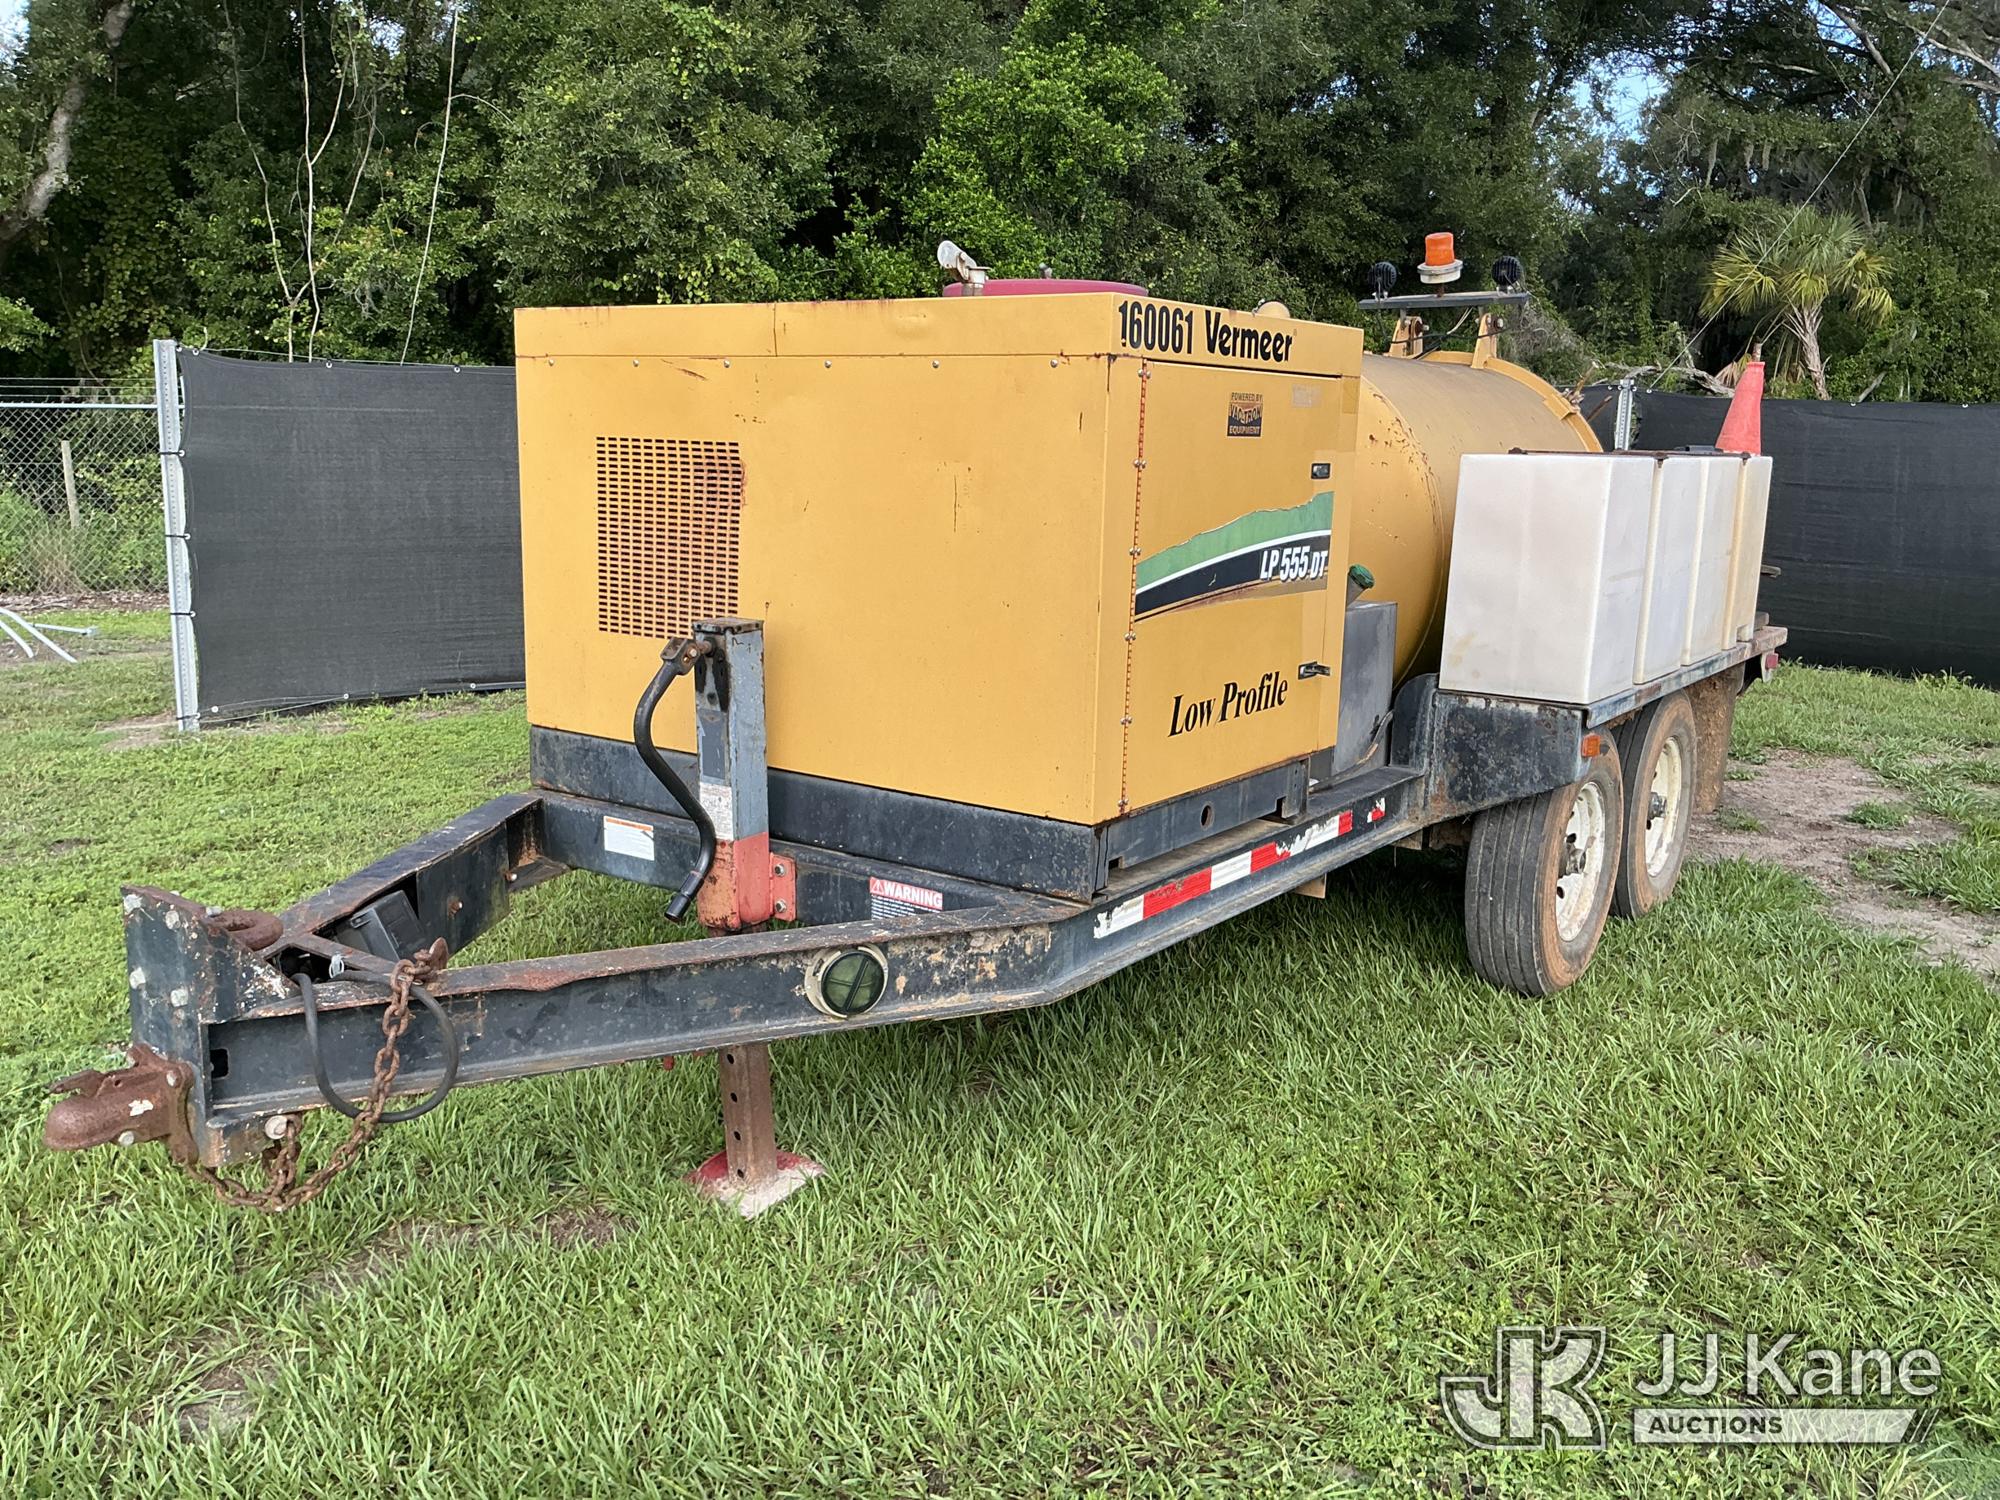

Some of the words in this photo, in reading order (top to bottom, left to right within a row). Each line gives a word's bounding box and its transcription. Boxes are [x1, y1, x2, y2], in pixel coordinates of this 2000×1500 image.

[1119, 300, 1193, 354] 160061
[1205, 309, 1292, 362] Vermeer
[1229, 425, 1261, 435] EQUIPMENT
[1260, 549, 1279, 580] LP
[1280, 546, 1310, 582] 555
[1310, 550, 1329, 579] DT
[1168, 694, 1216, 737] Low
[1217, 671, 1288, 723] Profile
[883, 880, 942, 908] WARNING
